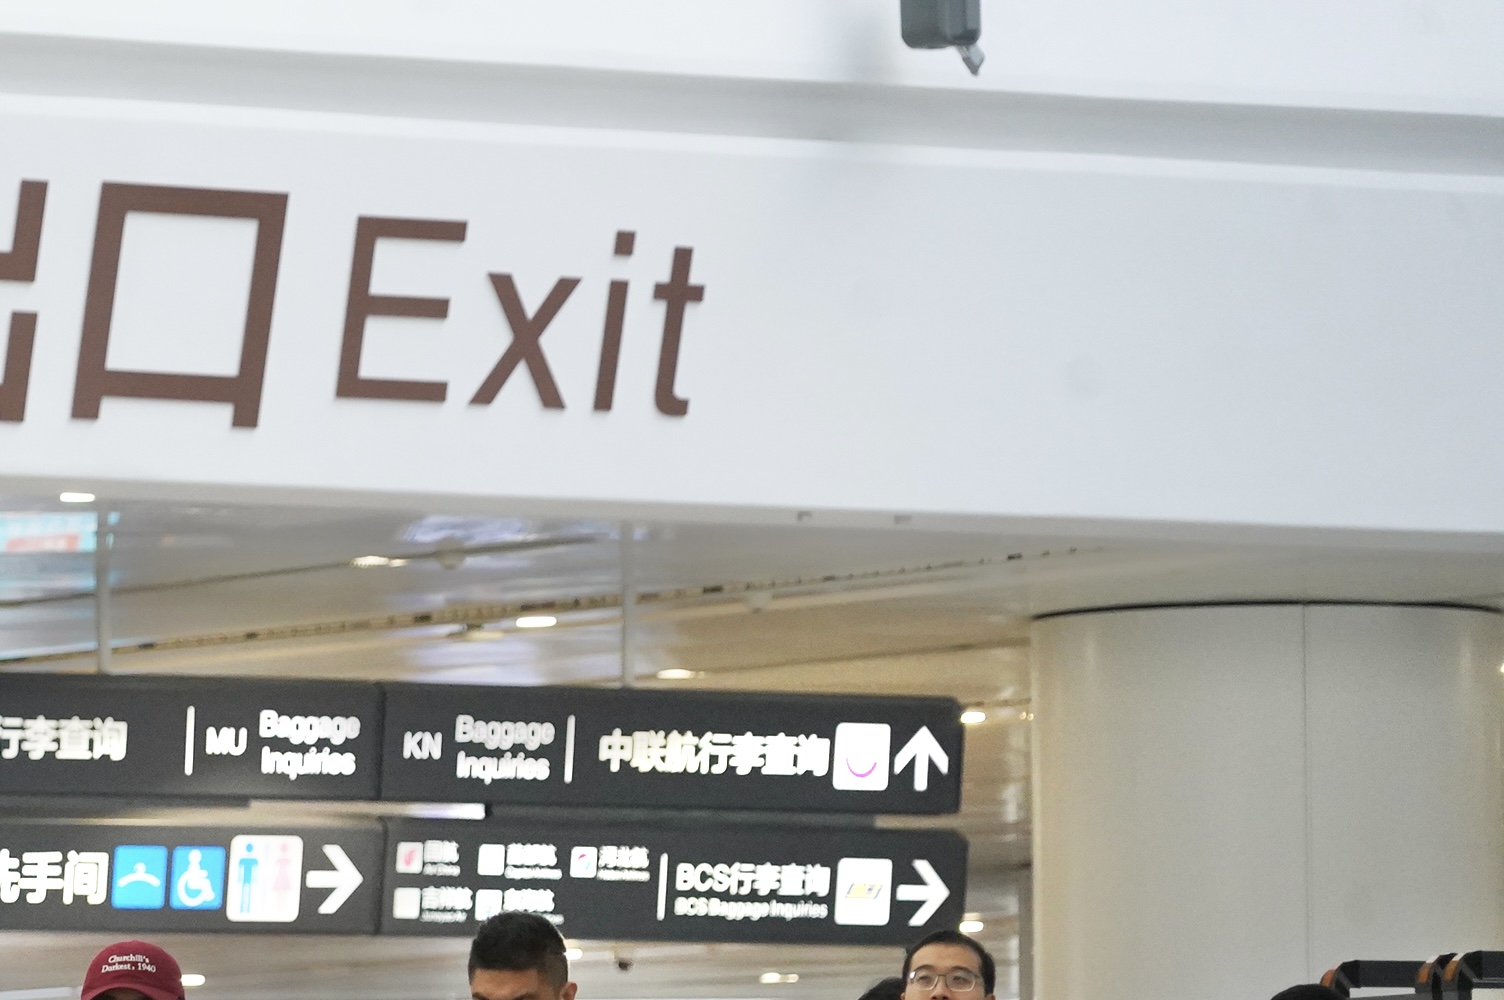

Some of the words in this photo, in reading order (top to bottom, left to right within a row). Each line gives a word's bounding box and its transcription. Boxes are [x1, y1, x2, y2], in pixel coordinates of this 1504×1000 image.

[334, 215, 706, 418] Exit
[205, 726, 248, 757] MU
[259, 709, 361, 745] Baggage
[402, 730, 443, 760] KN
[455, 714, 556, 751] Baggage
[260, 745, 356, 781] Inquiries
[456, 750, 551, 785] Inquiries
[598, 727, 831, 777] 中联航行李查询
[675, 861, 831, 897] BCS行李查询
[107, 953, 150, 963] Churchill's
[137, 962, 156, 973] 1940
